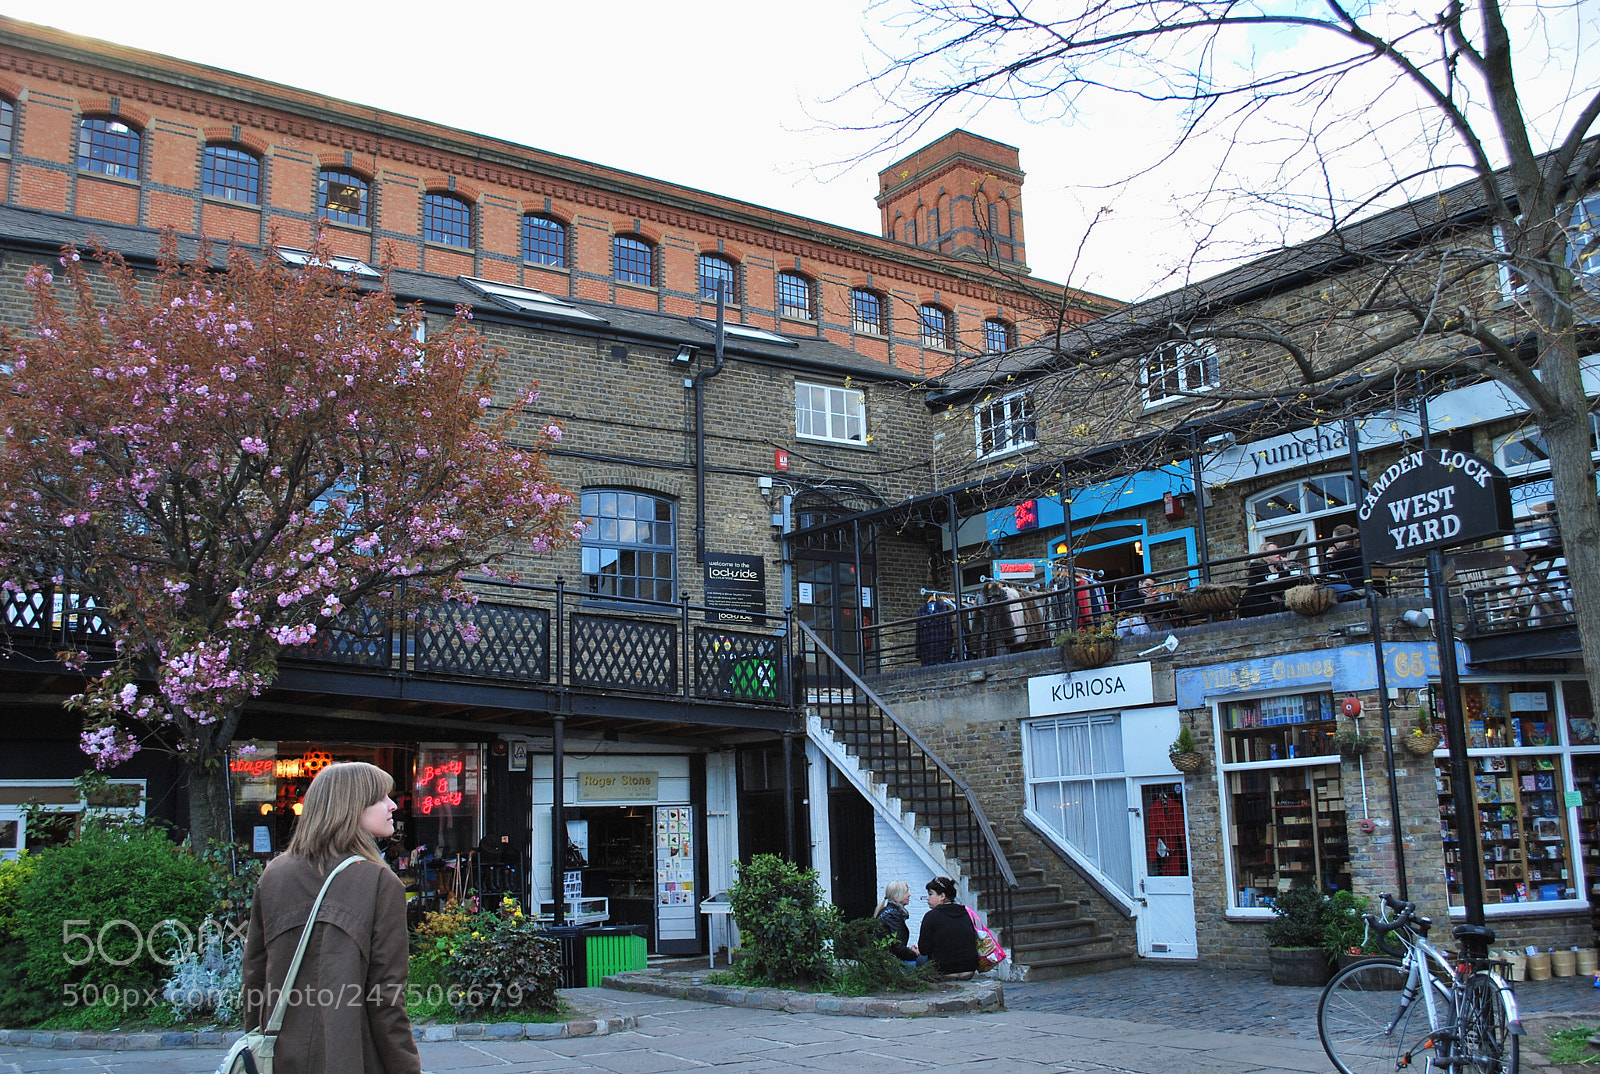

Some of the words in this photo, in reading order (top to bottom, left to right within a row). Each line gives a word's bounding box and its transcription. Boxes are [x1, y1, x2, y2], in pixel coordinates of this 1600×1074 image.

[1250, 424, 1357, 475] yumcha
[1359, 450, 1424, 521] CAMDEN
[1439, 449, 1492, 488] LOCK
[1388, 485, 1456, 523] WEST
[1389, 514, 1461, 550] YARD
[1200, 664, 1261, 691] Village
[1272, 659, 1336, 681] Games
[1394, 651, 1426, 678] 65
[1051, 676, 1126, 702] KURIOSA
[420, 761, 463, 786] Berty
[437, 777, 449, 793] &
[584, 775, 616, 788] Roger
[620, 774, 651, 786] Stone
[421, 791, 463, 814] Gerty
